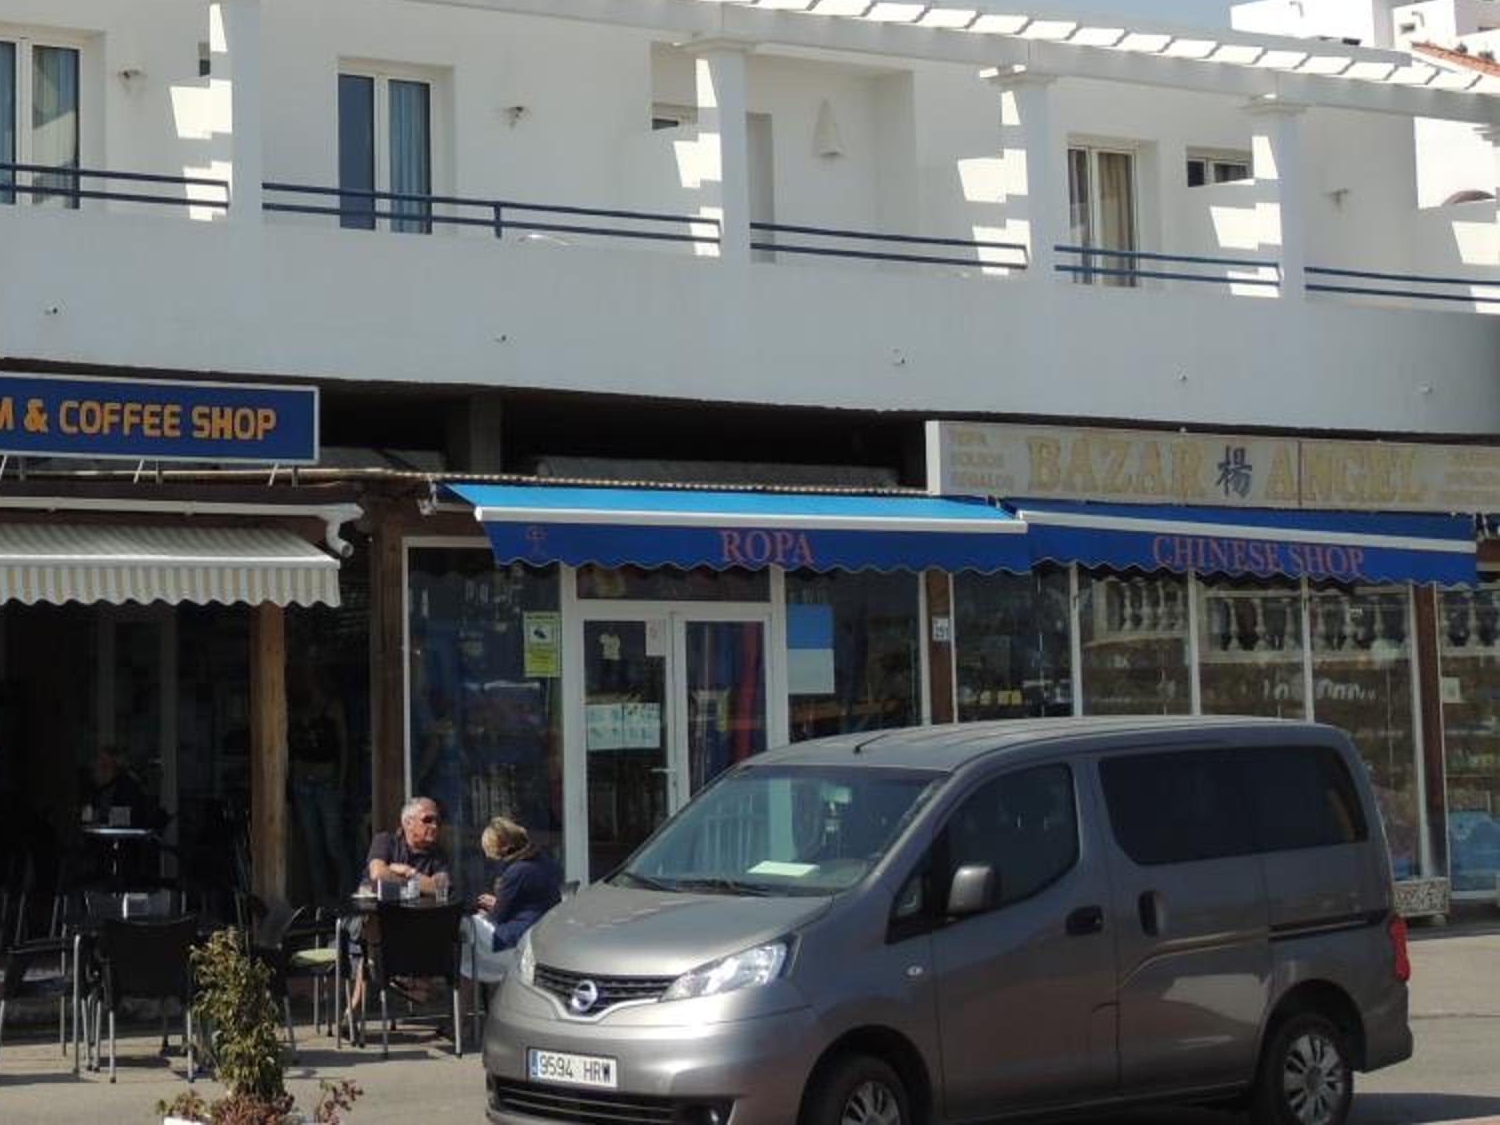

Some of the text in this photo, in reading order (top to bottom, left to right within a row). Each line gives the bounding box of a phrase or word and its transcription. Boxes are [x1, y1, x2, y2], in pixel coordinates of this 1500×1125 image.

[23, 397, 49, 432] &
[59, 400, 182, 438] COFFEE
[191, 406, 277, 441] SHOP
[1027, 436, 1207, 498] BAZAR
[1263, 441, 1425, 506] ANGEL
[720, 529, 814, 567] ROPA
[1153, 534, 1364, 576] CHINESE SHOP
[539, 1054, 611, 1083] 9594 HRW
